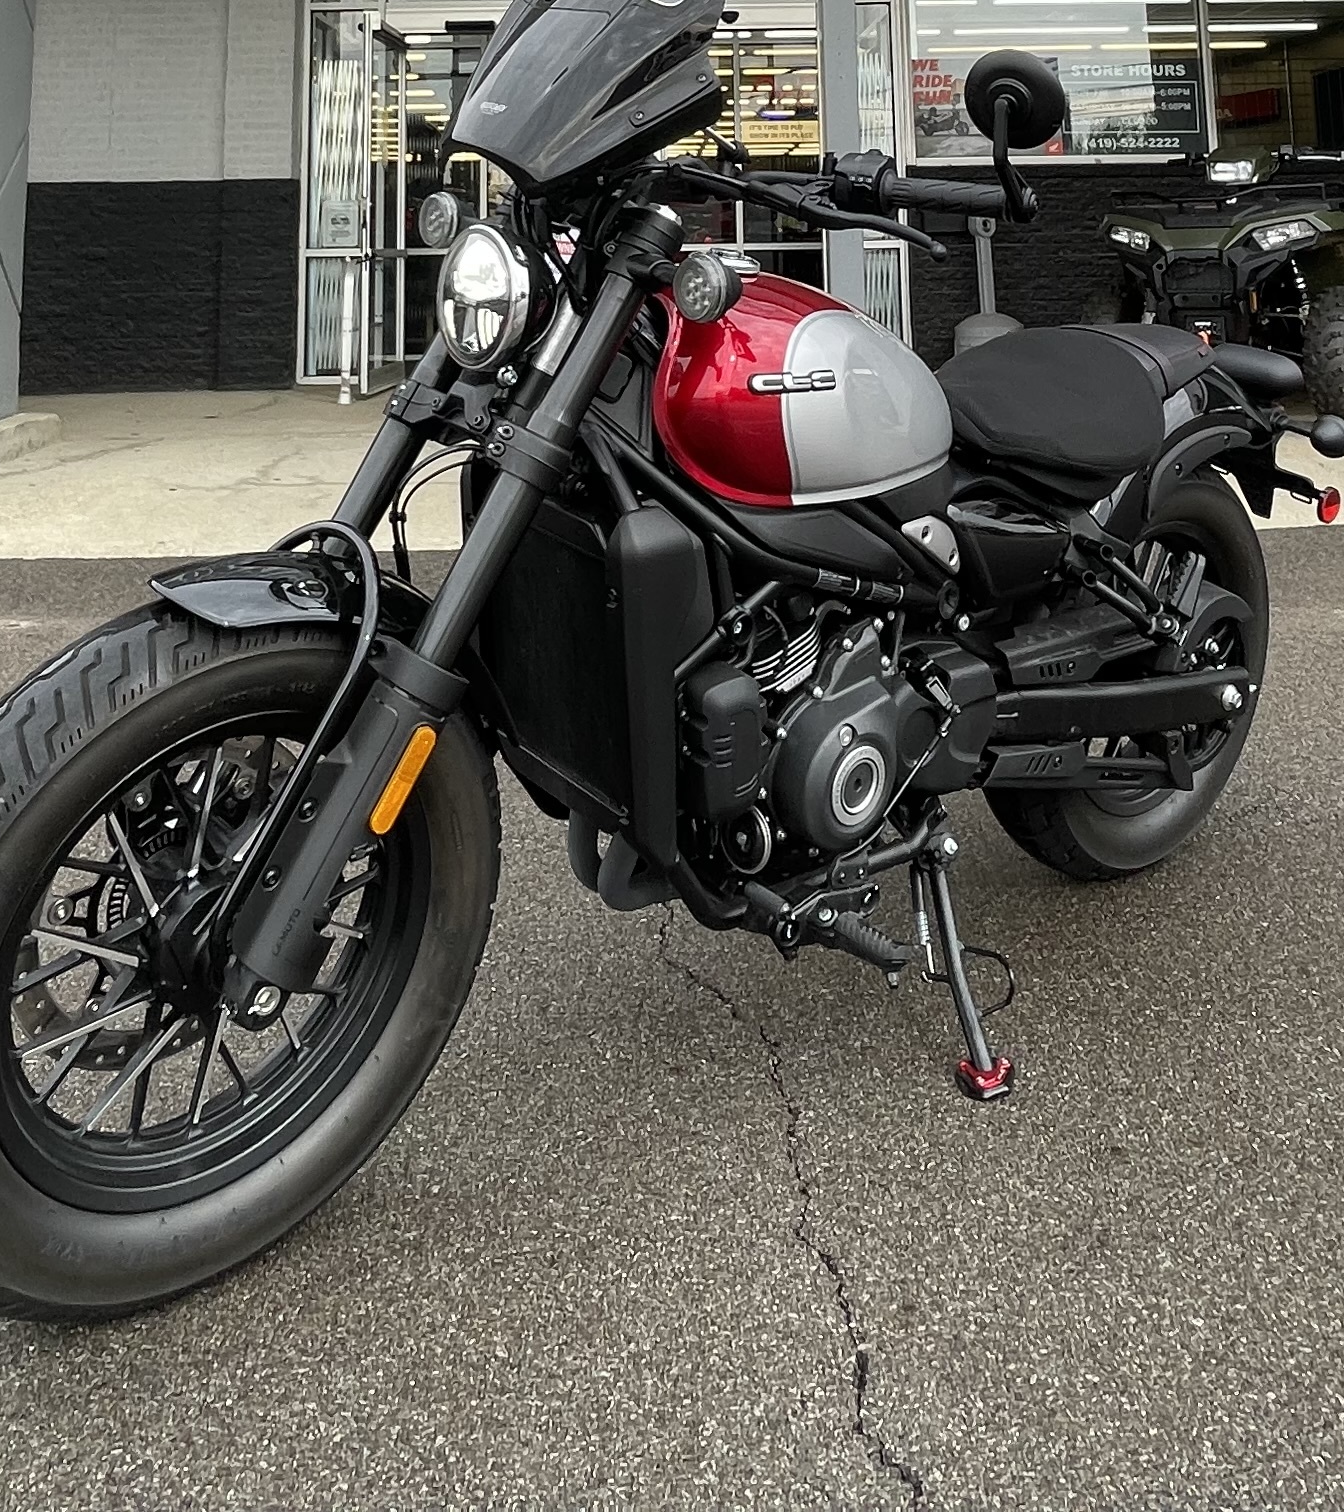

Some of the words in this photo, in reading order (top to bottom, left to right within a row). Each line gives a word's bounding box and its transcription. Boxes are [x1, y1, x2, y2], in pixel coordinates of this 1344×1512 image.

[912, 59, 939, 72] WE
[1070, 64, 1124, 77] STORE
[1128, 64, 1187, 77] HOURS
[912, 74, 953, 88] RIDE
